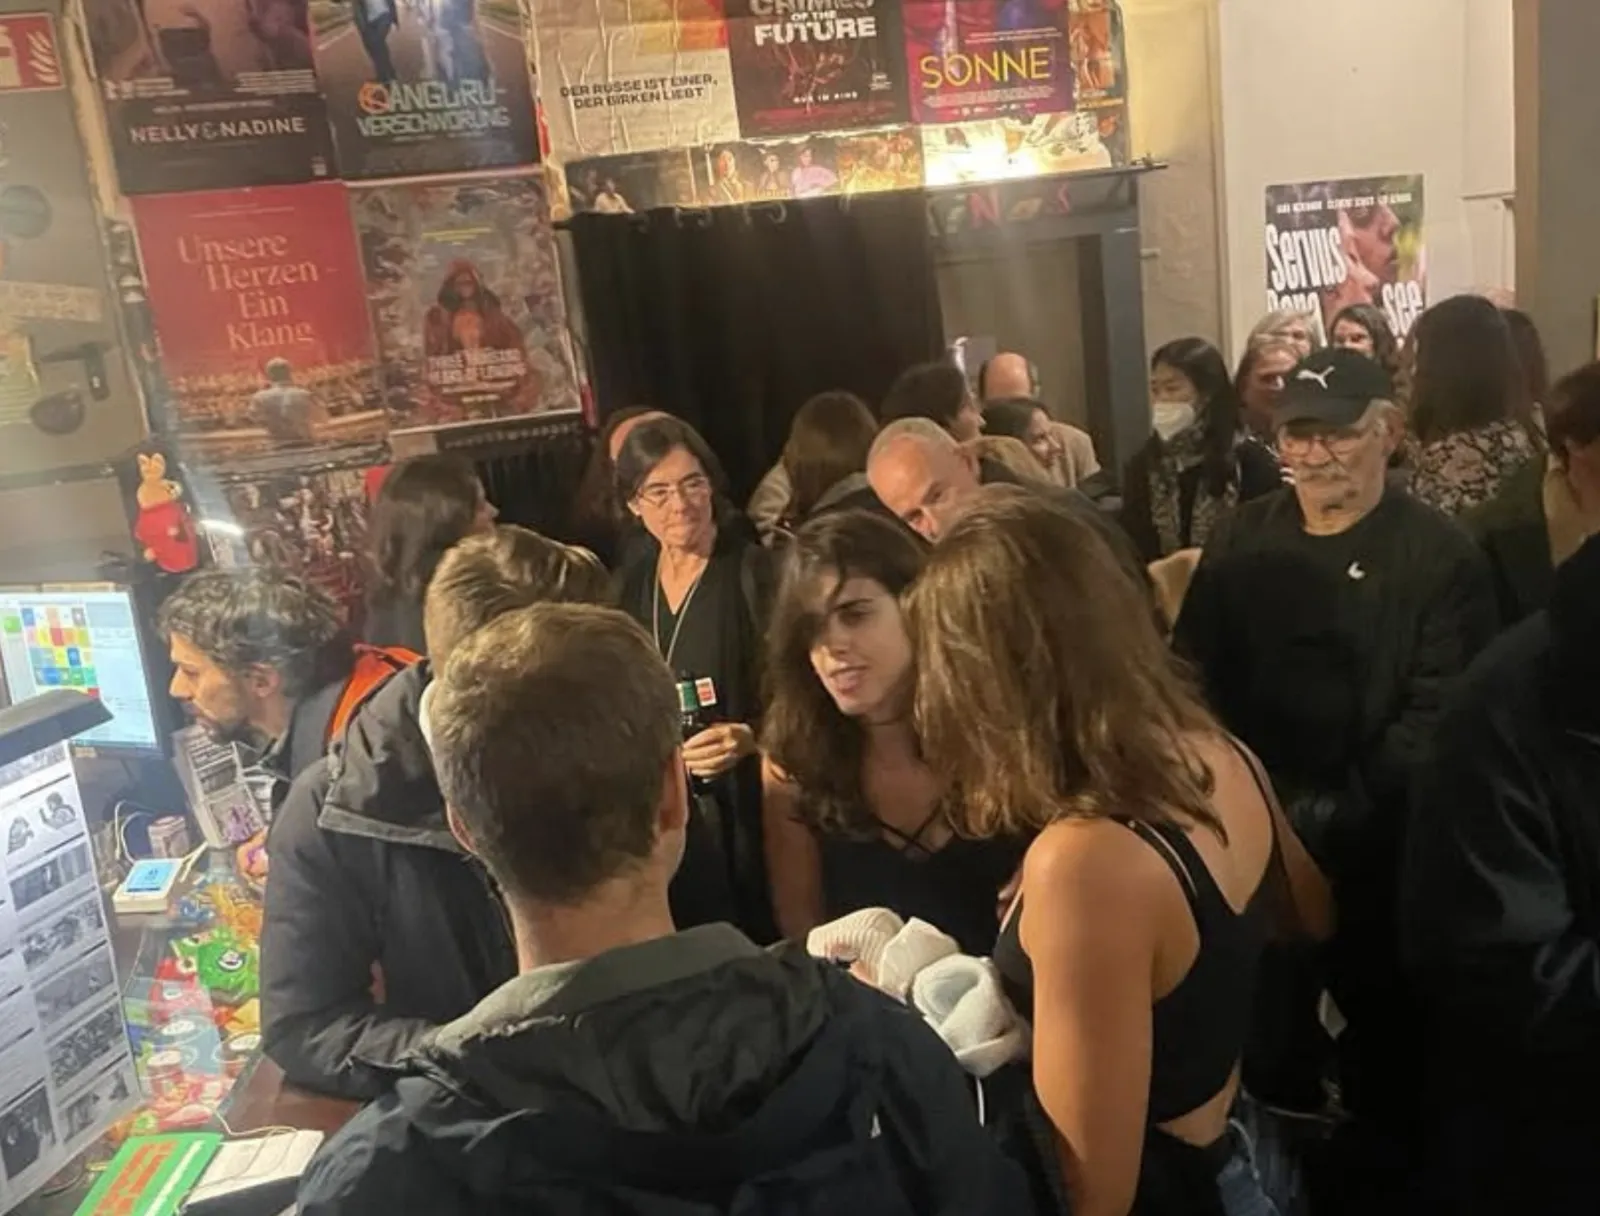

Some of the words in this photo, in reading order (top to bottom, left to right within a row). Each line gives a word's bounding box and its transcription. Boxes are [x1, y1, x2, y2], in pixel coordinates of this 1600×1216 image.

[791, 12, 809, 21] OF
[812, 10, 837, 20] THE
[754, 16, 877, 46] FUTURE
[920, 47, 1051, 89] SONNE
[560, 85, 591, 98] DER
[593, 79, 642, 95] RUSSE
[644, 77, 667, 90] IST
[671, 73, 719, 87] EINER,
[574, 96, 604, 109] DER
[607, 92, 661, 106] BIRKEN
[664, 87, 704, 101] LIEBT
[130, 122, 199, 143] NELLY
[219, 116, 307, 138] NADINE
[177, 234, 288, 264] Unsere
[1265, 223, 1348, 291] Servus
[206, 261, 320, 292] Herzen
[238, 291, 289, 320] Ein
[226, 321, 316, 349] Klang
